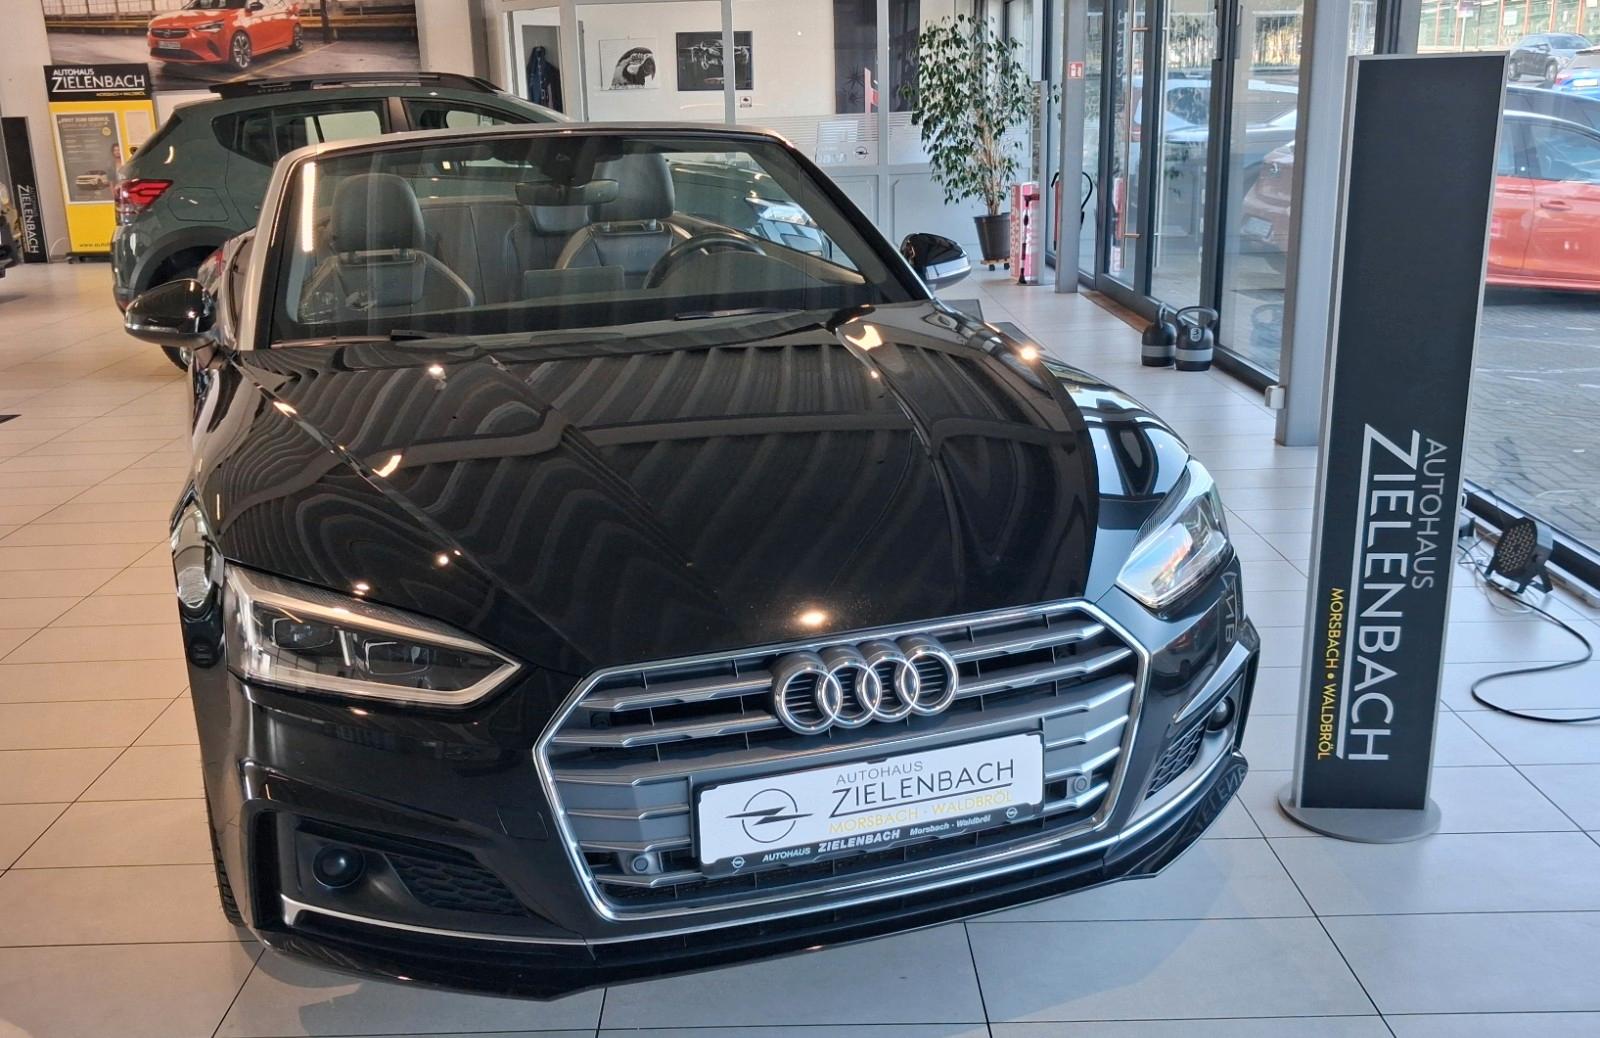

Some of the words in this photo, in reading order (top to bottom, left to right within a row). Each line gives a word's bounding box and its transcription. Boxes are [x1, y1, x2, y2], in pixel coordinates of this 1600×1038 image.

[51, 75, 146, 93] ZIELENBACH
[53, 68, 95, 76] AUTOHAUS
[17, 184, 40, 254] ZIELENBACH
[1411, 438, 1448, 589] AUTOHAUS
[1338, 423, 1420, 760] ZIELENBACH
[1325, 587, 1345, 669] MORSBACH
[1317, 683, 1337, 760] WALDBRÖL
[828, 758, 1014, 818] ZIELENBACH
[835, 760, 924, 786] AUTOHAUS
[761, 846, 812, 863] AUTOHAUS
[817, 828, 901, 853] ZIELENBACH
[909, 822, 950, 836] Morsbach
[956, 813, 992, 828] Waldbröl
[828, 807, 919, 834] MORSBACH
[931, 789, 1014, 815] WALDBRÖL
